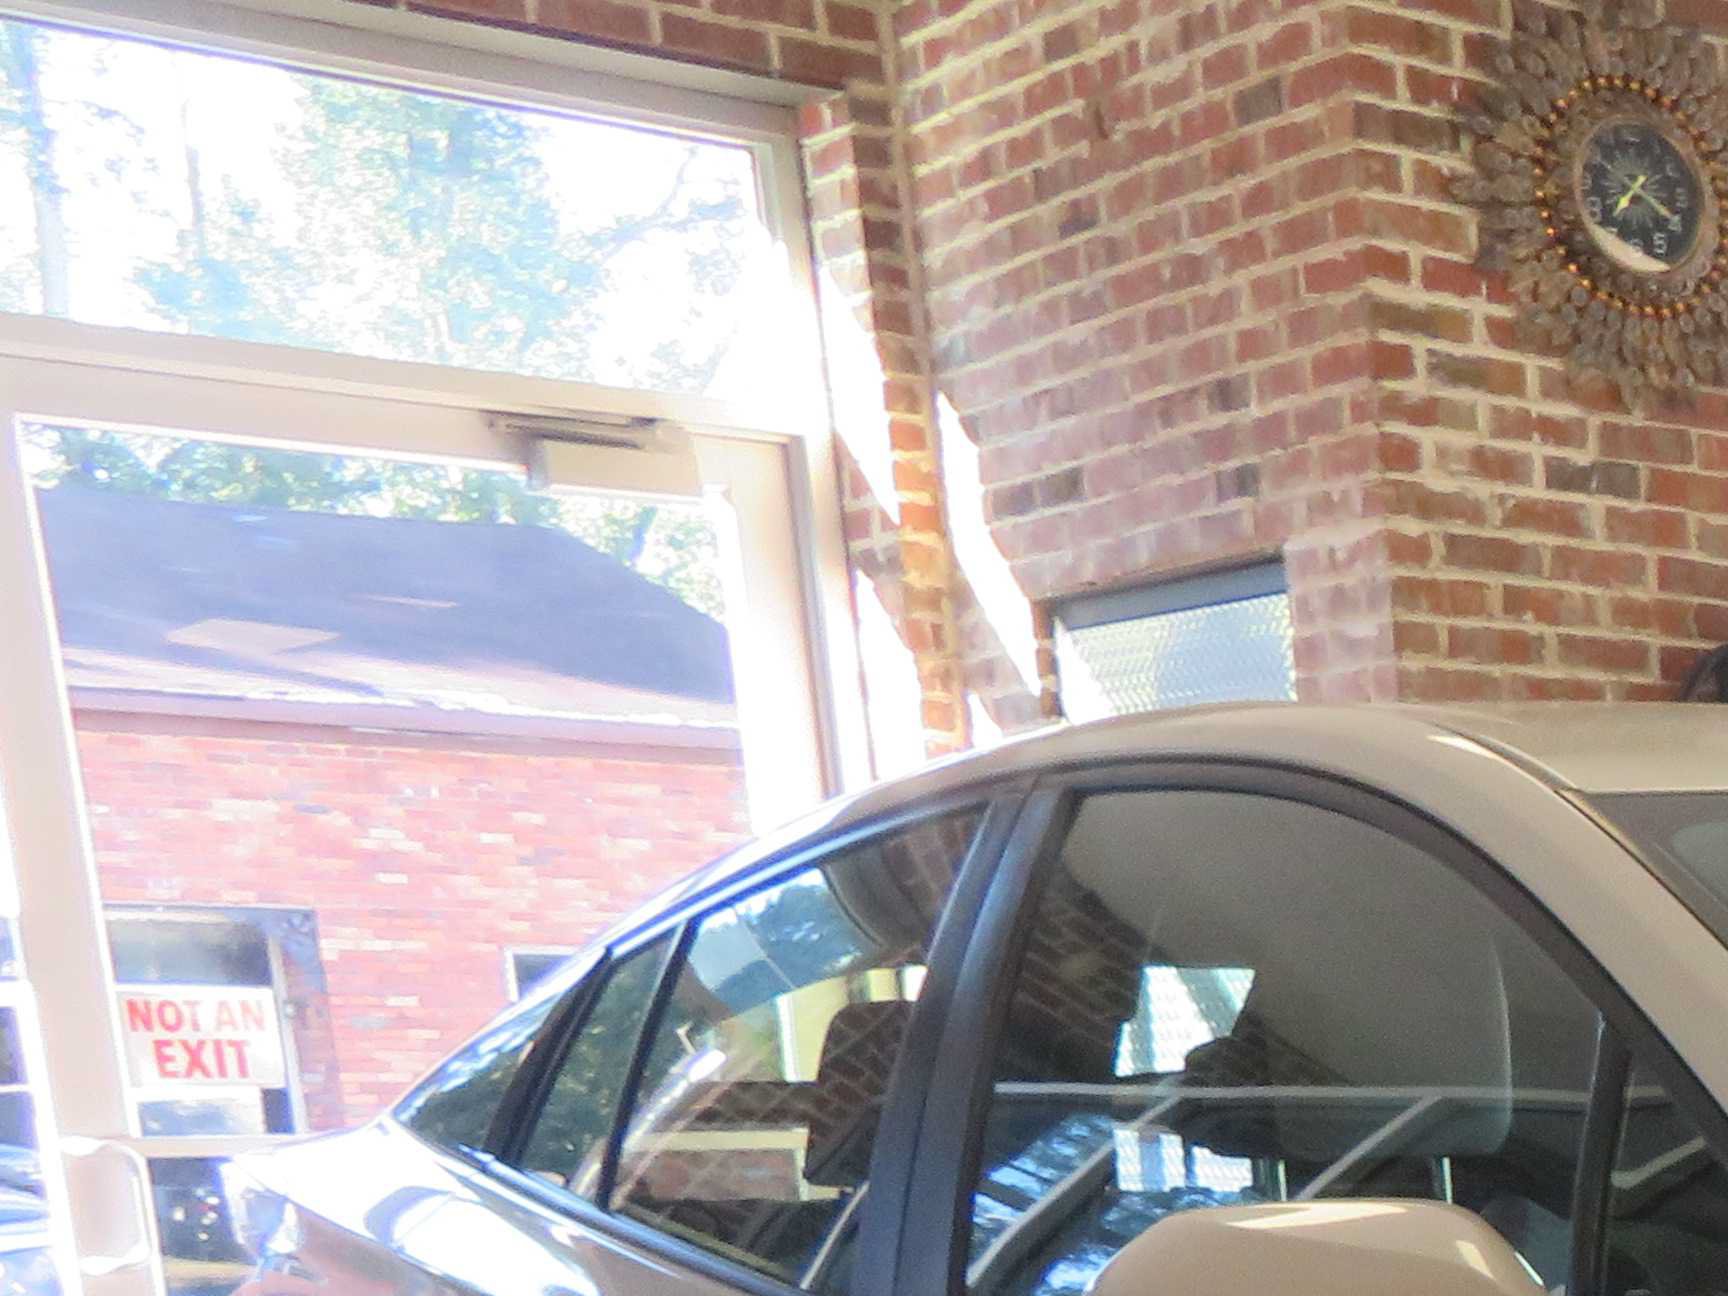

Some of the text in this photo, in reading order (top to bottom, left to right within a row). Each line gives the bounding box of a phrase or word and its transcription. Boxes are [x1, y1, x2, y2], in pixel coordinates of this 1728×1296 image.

[1653, 232, 1667, 257] 5
[126, 998, 266, 1032] NOT AN
[152, 1038, 251, 1079] EXIT
